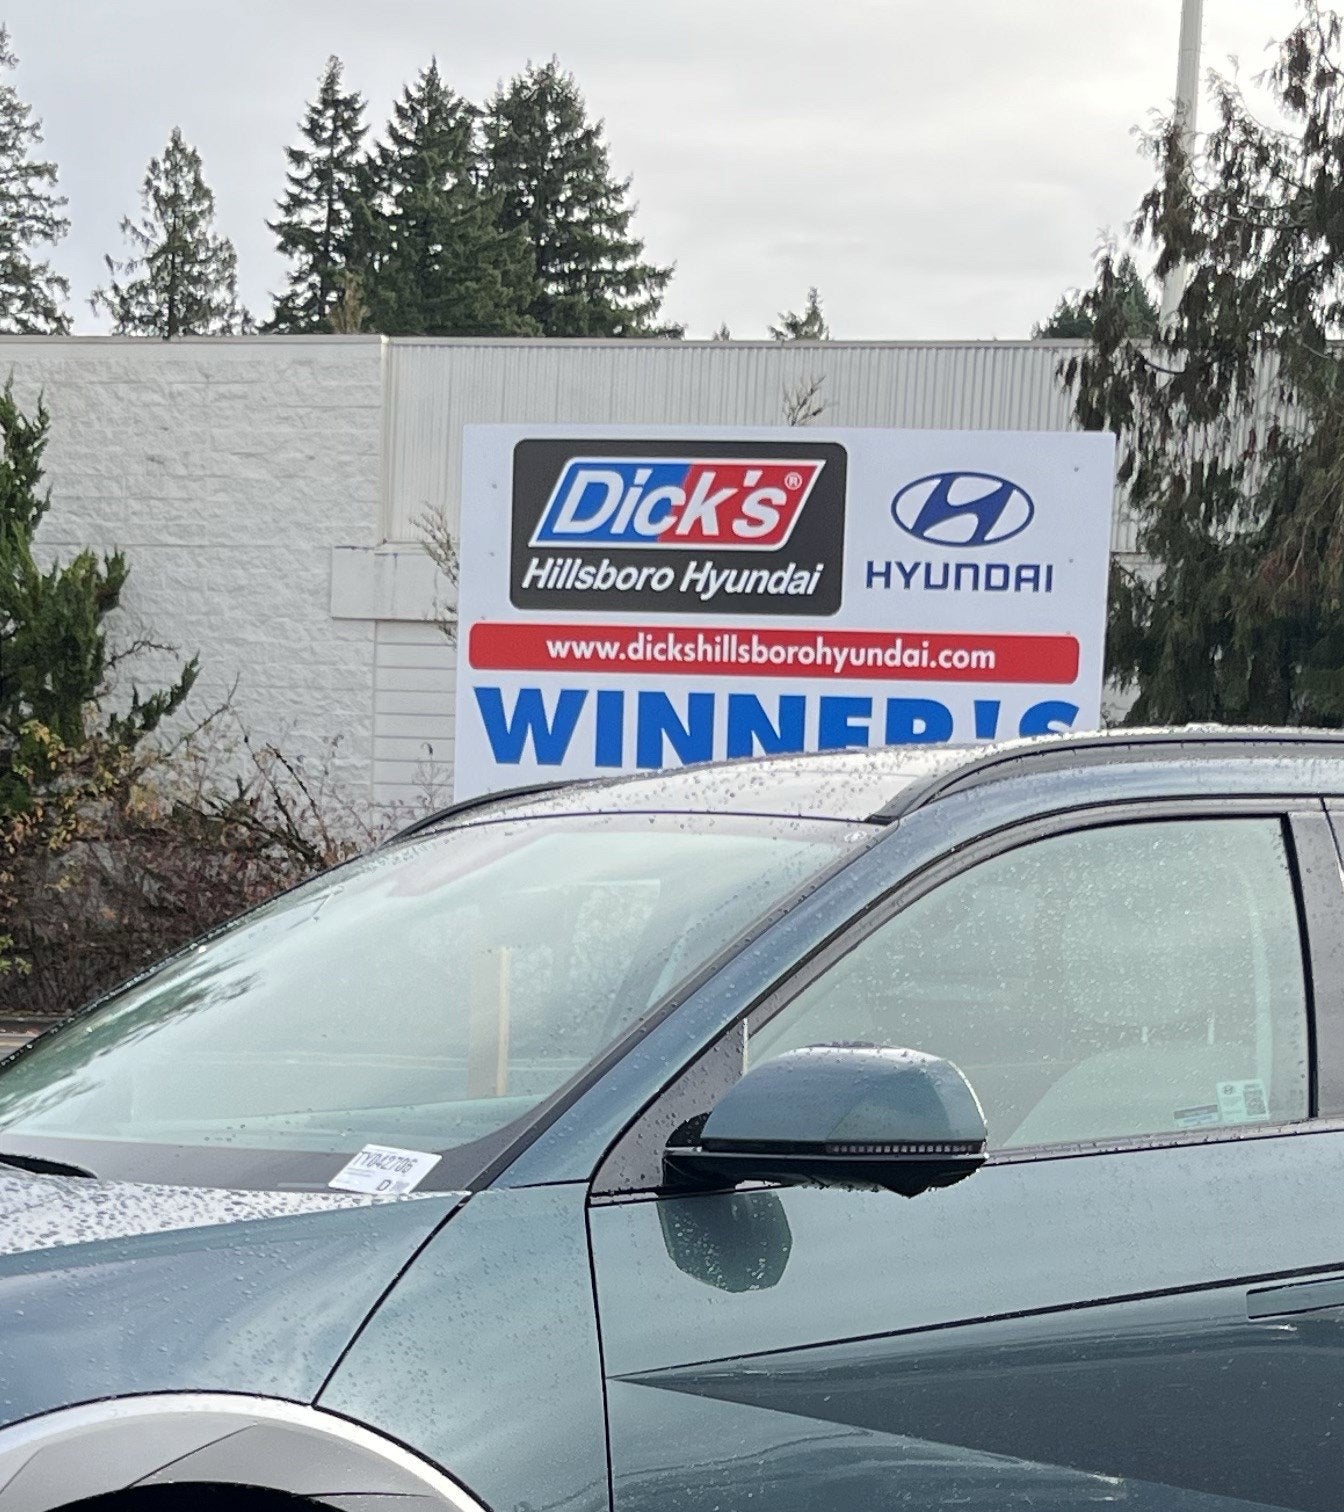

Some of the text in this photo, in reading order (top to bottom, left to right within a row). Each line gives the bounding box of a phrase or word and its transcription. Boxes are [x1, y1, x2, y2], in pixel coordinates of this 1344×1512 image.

[521, 557, 824, 601] Hillsboro Hyundai
[867, 560, 1053, 593] HYUNDAI
[546, 634, 996, 675] www.dickshillsborohyundai.com
